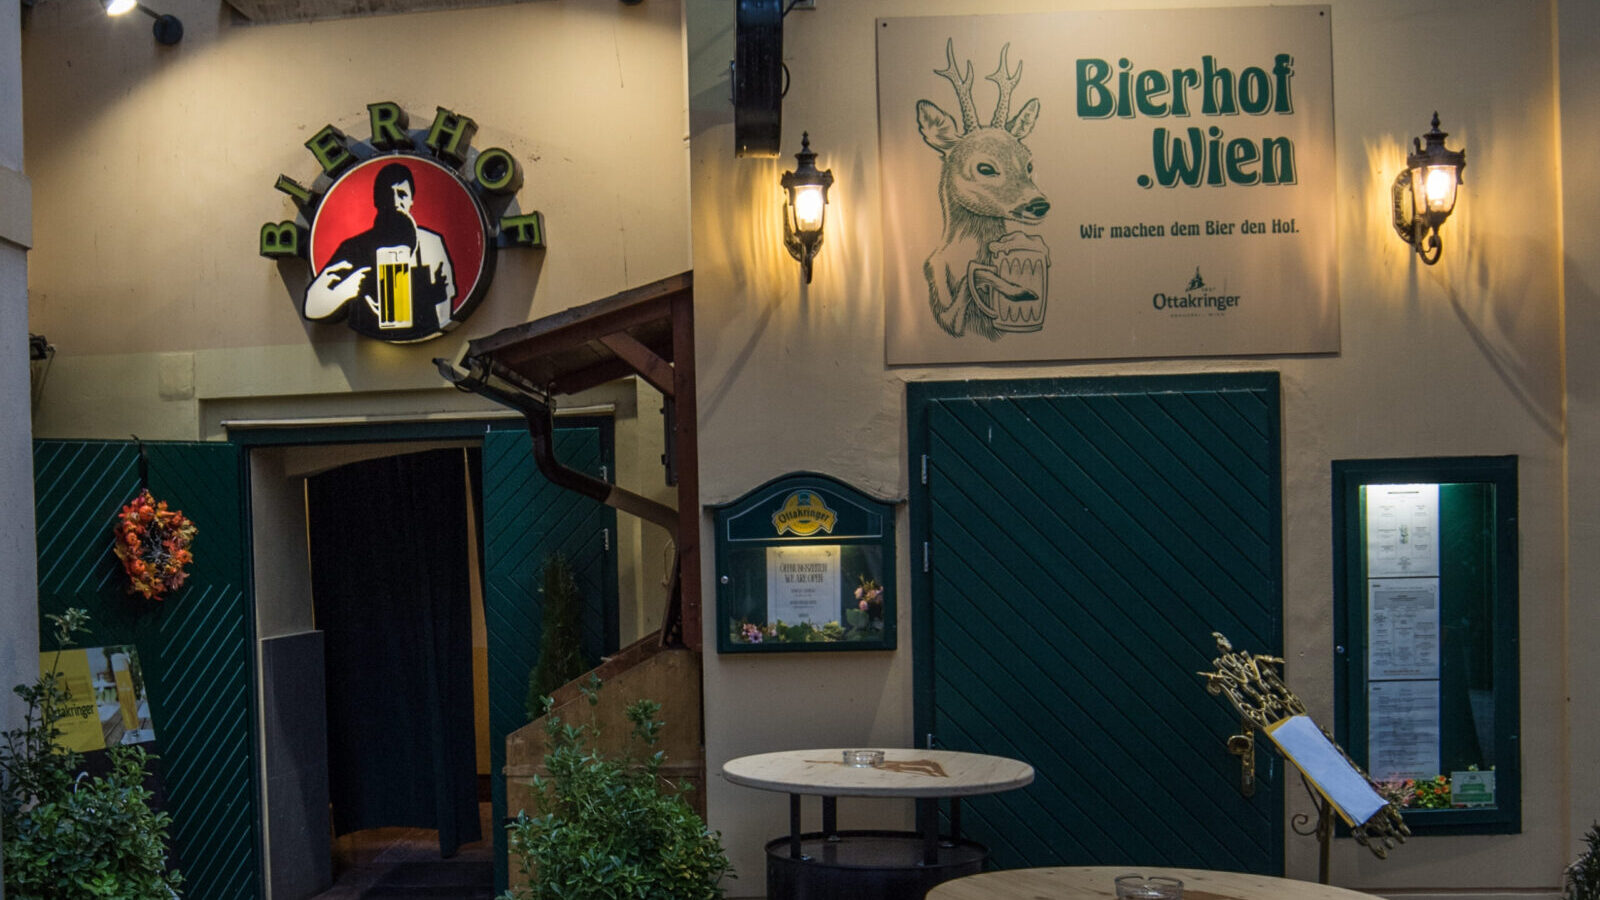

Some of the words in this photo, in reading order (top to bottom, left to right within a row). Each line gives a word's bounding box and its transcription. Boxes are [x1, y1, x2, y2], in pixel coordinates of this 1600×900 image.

[1076, 54, 1294, 119] Bierhof
[1137, 126, 1297, 188] .Wien
[260, 102, 546, 258] BIERHOF
[1080, 224, 1104, 239] Wir
[1110, 223, 1165, 238] machen
[1170, 222, 1200, 236] dem
[1205, 220, 1235, 235] Bier
[1241, 219, 1266, 234] den
[1271, 218, 1300, 233] Hof.
[1153, 293, 1241, 311] Ottakringer
[778, 508, 830, 524] Ottakringer
[47, 704, 94, 720] Otakringer
